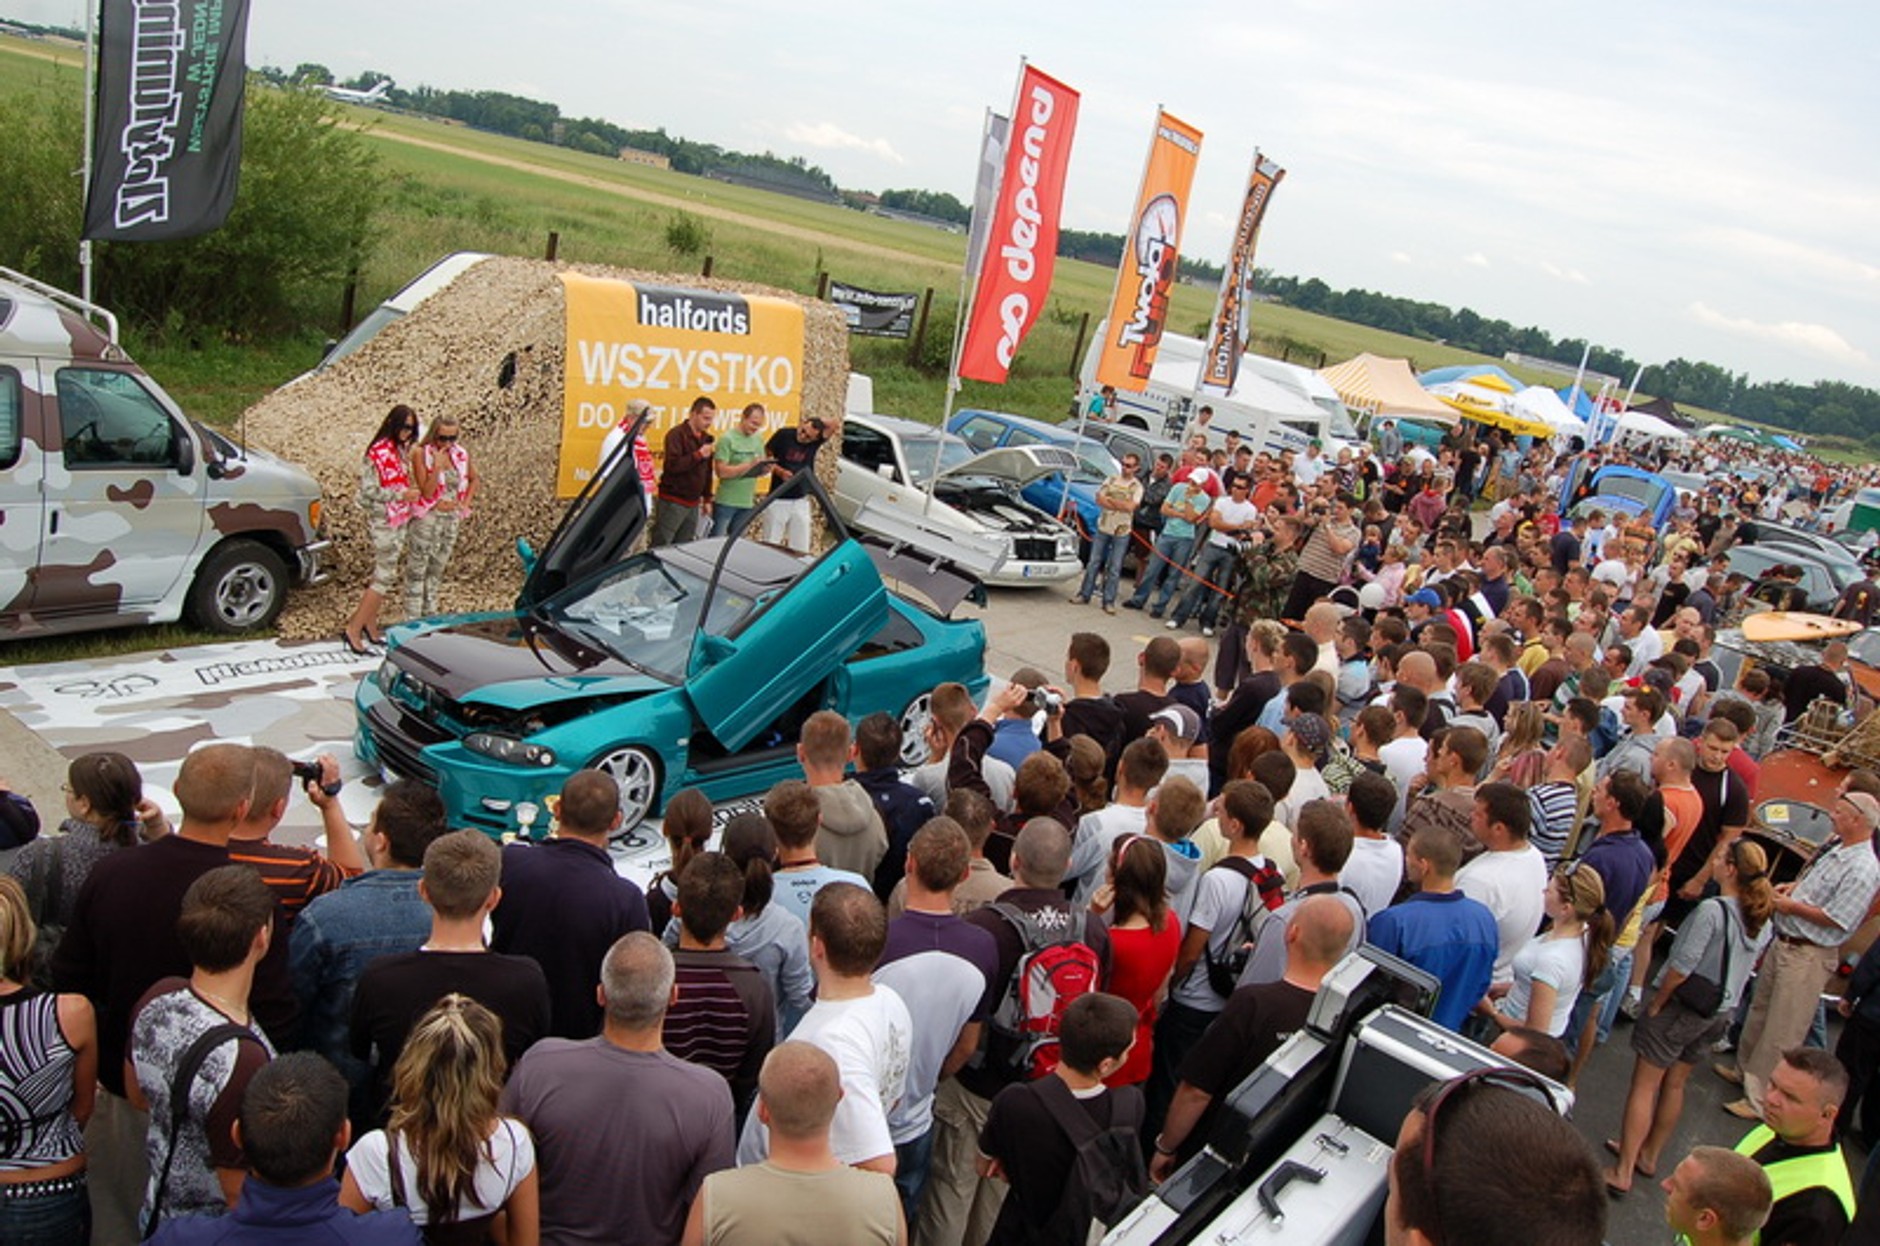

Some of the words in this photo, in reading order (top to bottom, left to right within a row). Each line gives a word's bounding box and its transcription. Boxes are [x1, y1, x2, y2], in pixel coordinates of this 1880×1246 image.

[1001, 86, 1055, 283] depend
[641, 294, 749, 335] halfords
[578, 339, 794, 396] WSZYSTKO
[578, 402, 615, 429] DO
